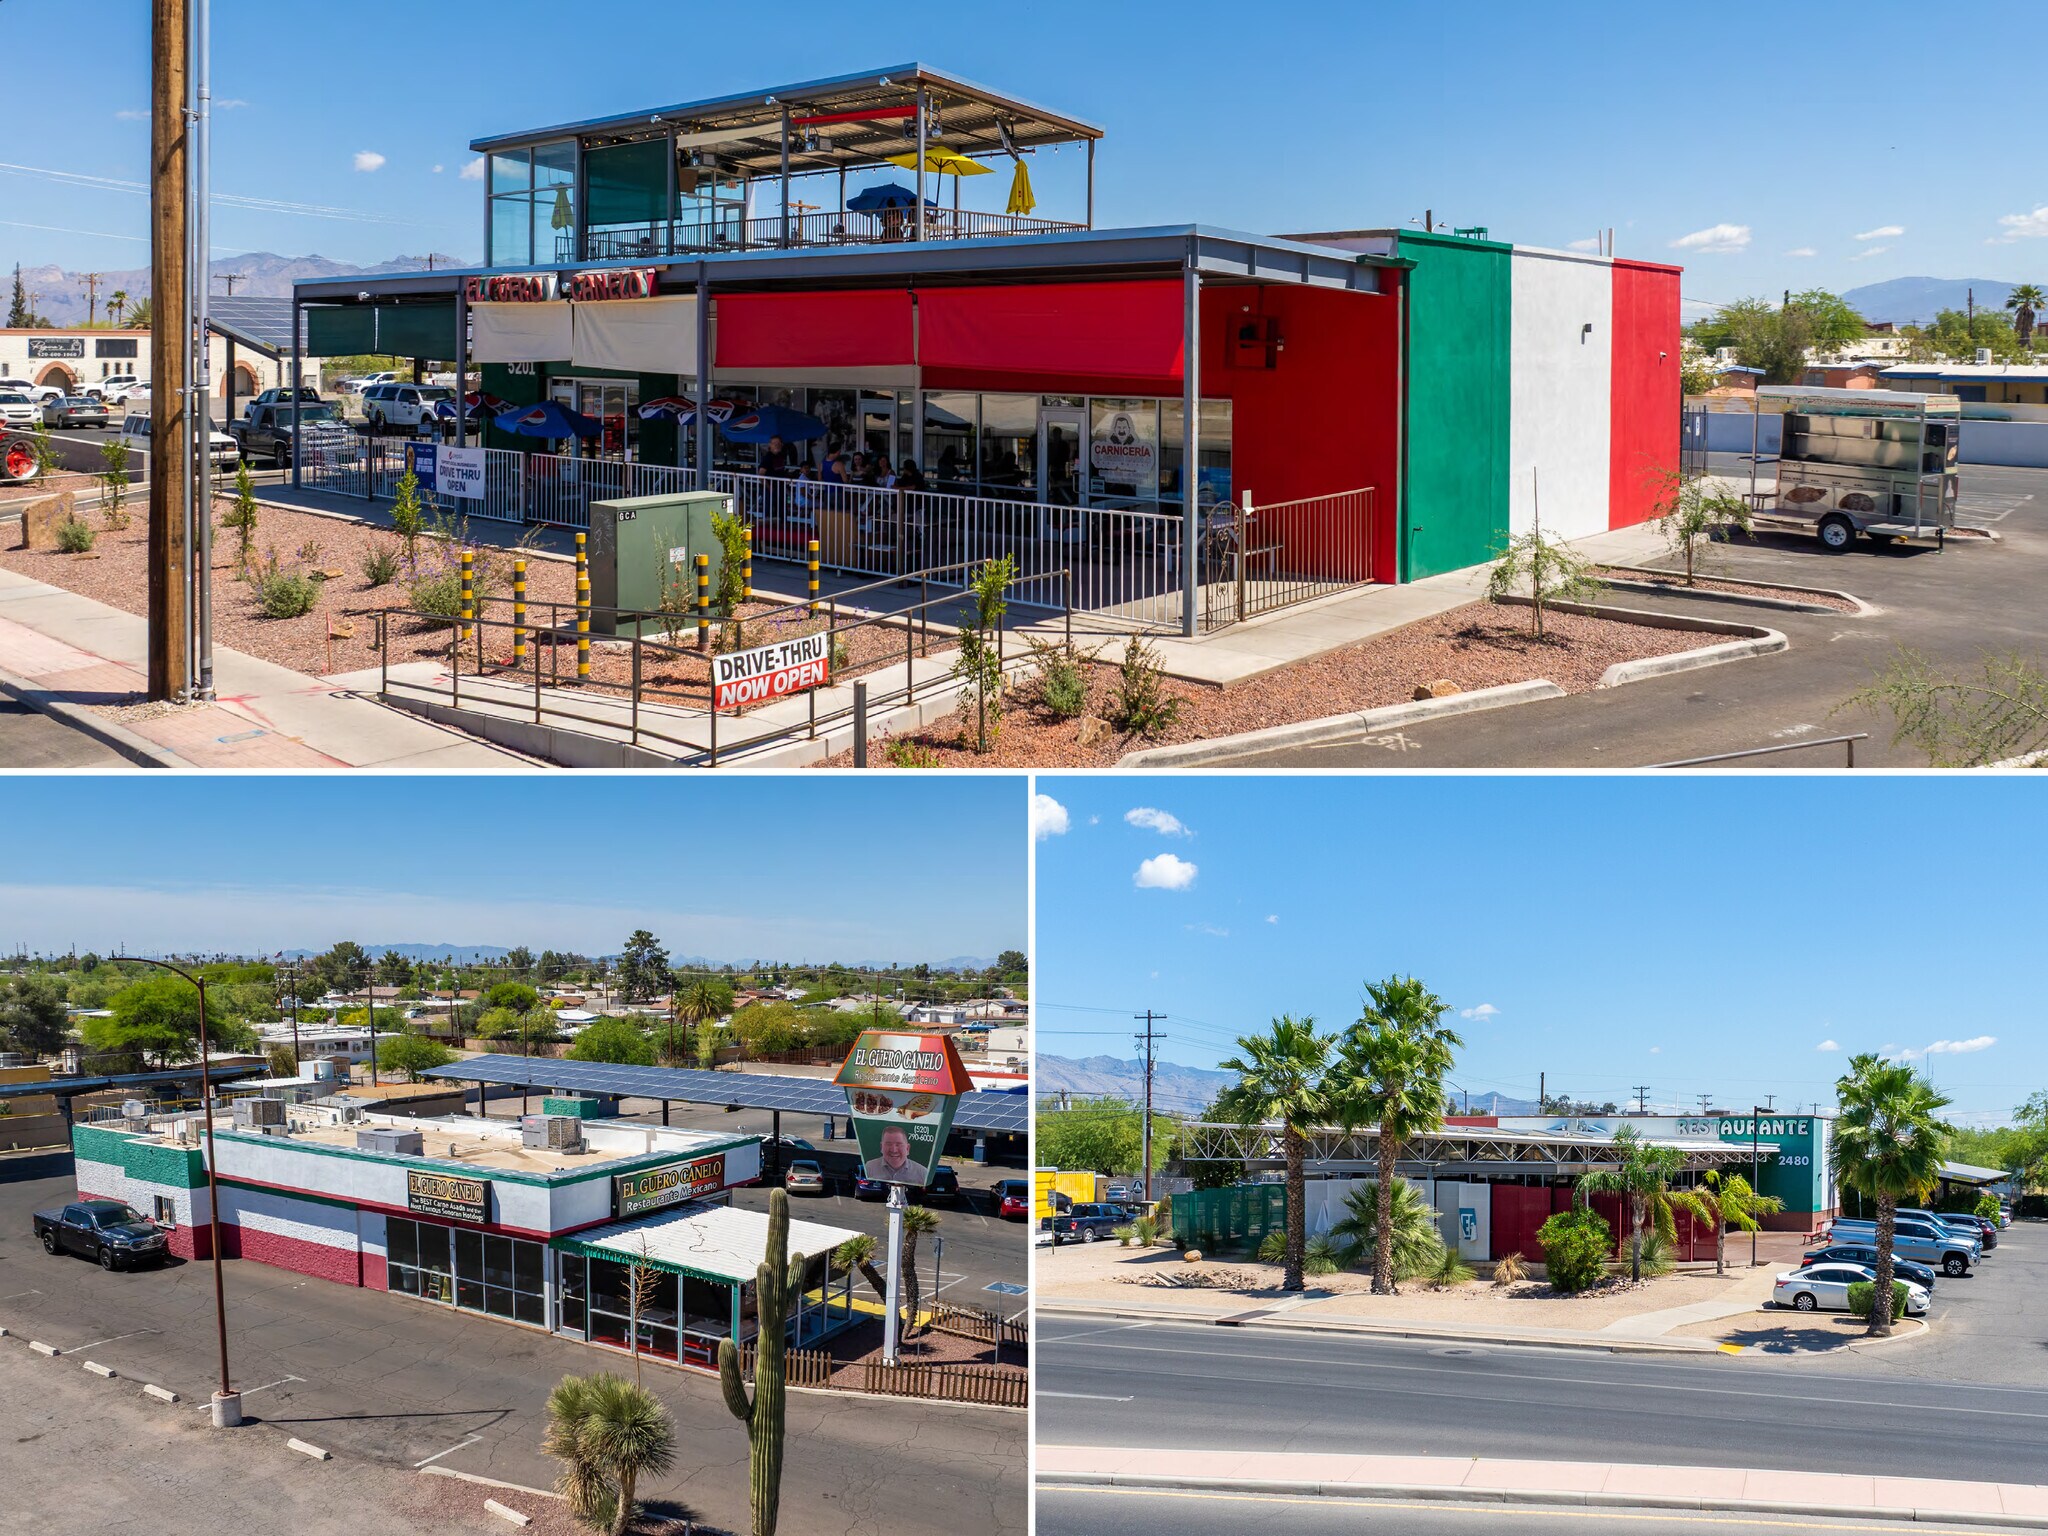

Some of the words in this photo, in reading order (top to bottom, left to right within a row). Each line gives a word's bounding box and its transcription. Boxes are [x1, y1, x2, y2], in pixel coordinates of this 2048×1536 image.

[466, 277, 485, 302] EL
[571, 272, 643, 302] CANELO
[508, 361, 536, 375] 5201
[1094, 445, 1151, 457] CARNICERÍA
[440, 465, 455, 478] DRIVE
[456, 468, 481, 480] THRU
[447, 480, 466, 492] OPEN
[619, 511, 636, 520] GCA
[720, 636, 822, 681] DRIVE-THRU
[720, 676, 771, 707] NOW
[773, 661, 823, 693] OPEN
[855, 1048, 866, 1066] EL
[868, 1048, 902, 1068] GÜERO
[903, 1050, 944, 1071] CANELO
[855, 1070, 900, 1084] Restaurante
[914, 1125, 930, 1134] (520)
[1676, 1118, 1809, 1136] RESTAURANTE
[908, 1132, 934, 1142] 790-6000
[1778, 1155, 1809, 1166] 2480
[623, 1181, 637, 1199] EL
[680, 1160, 722, 1184] CANELO
[410, 1175, 420, 1193] EL
[449, 1182, 483, 1203] CANELO
[420, 1198, 432, 1206] BEST
[433, 1199, 449, 1208] Carne
[627, 1190, 679, 1212] Restaurante
[680, 1181, 718, 1198] Mexicano
[422, 1205, 441, 1214] Famous
[442, 1208, 463, 1217] Sonoran
